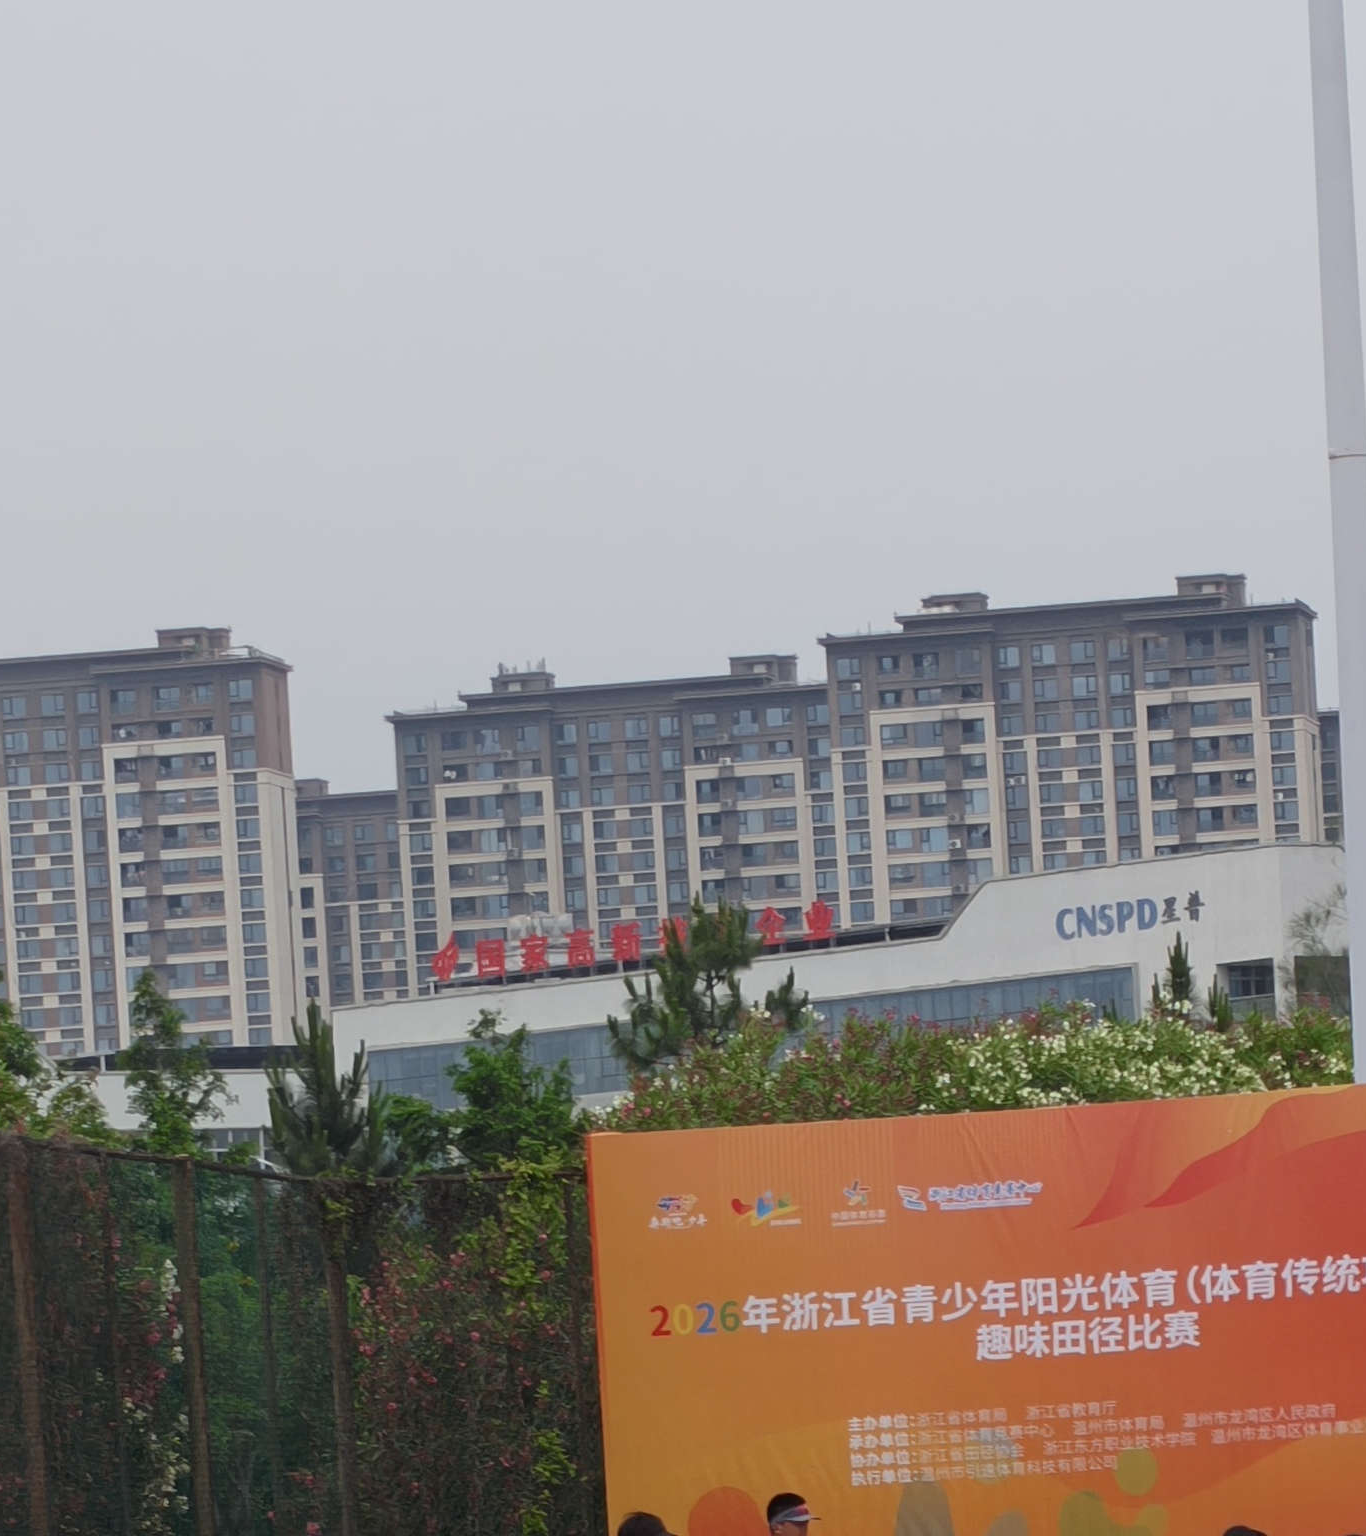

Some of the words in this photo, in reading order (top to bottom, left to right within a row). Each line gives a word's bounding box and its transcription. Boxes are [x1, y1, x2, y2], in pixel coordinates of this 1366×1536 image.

[1056, 898, 1157, 940] CNSPD
[1161, 890, 1205, 924] 星普
[976, 1310, 1201, 1361] 趣味田径比赛
[1025, 1401, 1116, 1420] 浙江省教育厅
[1072, 1415, 1164, 1436] 温州市体育局
